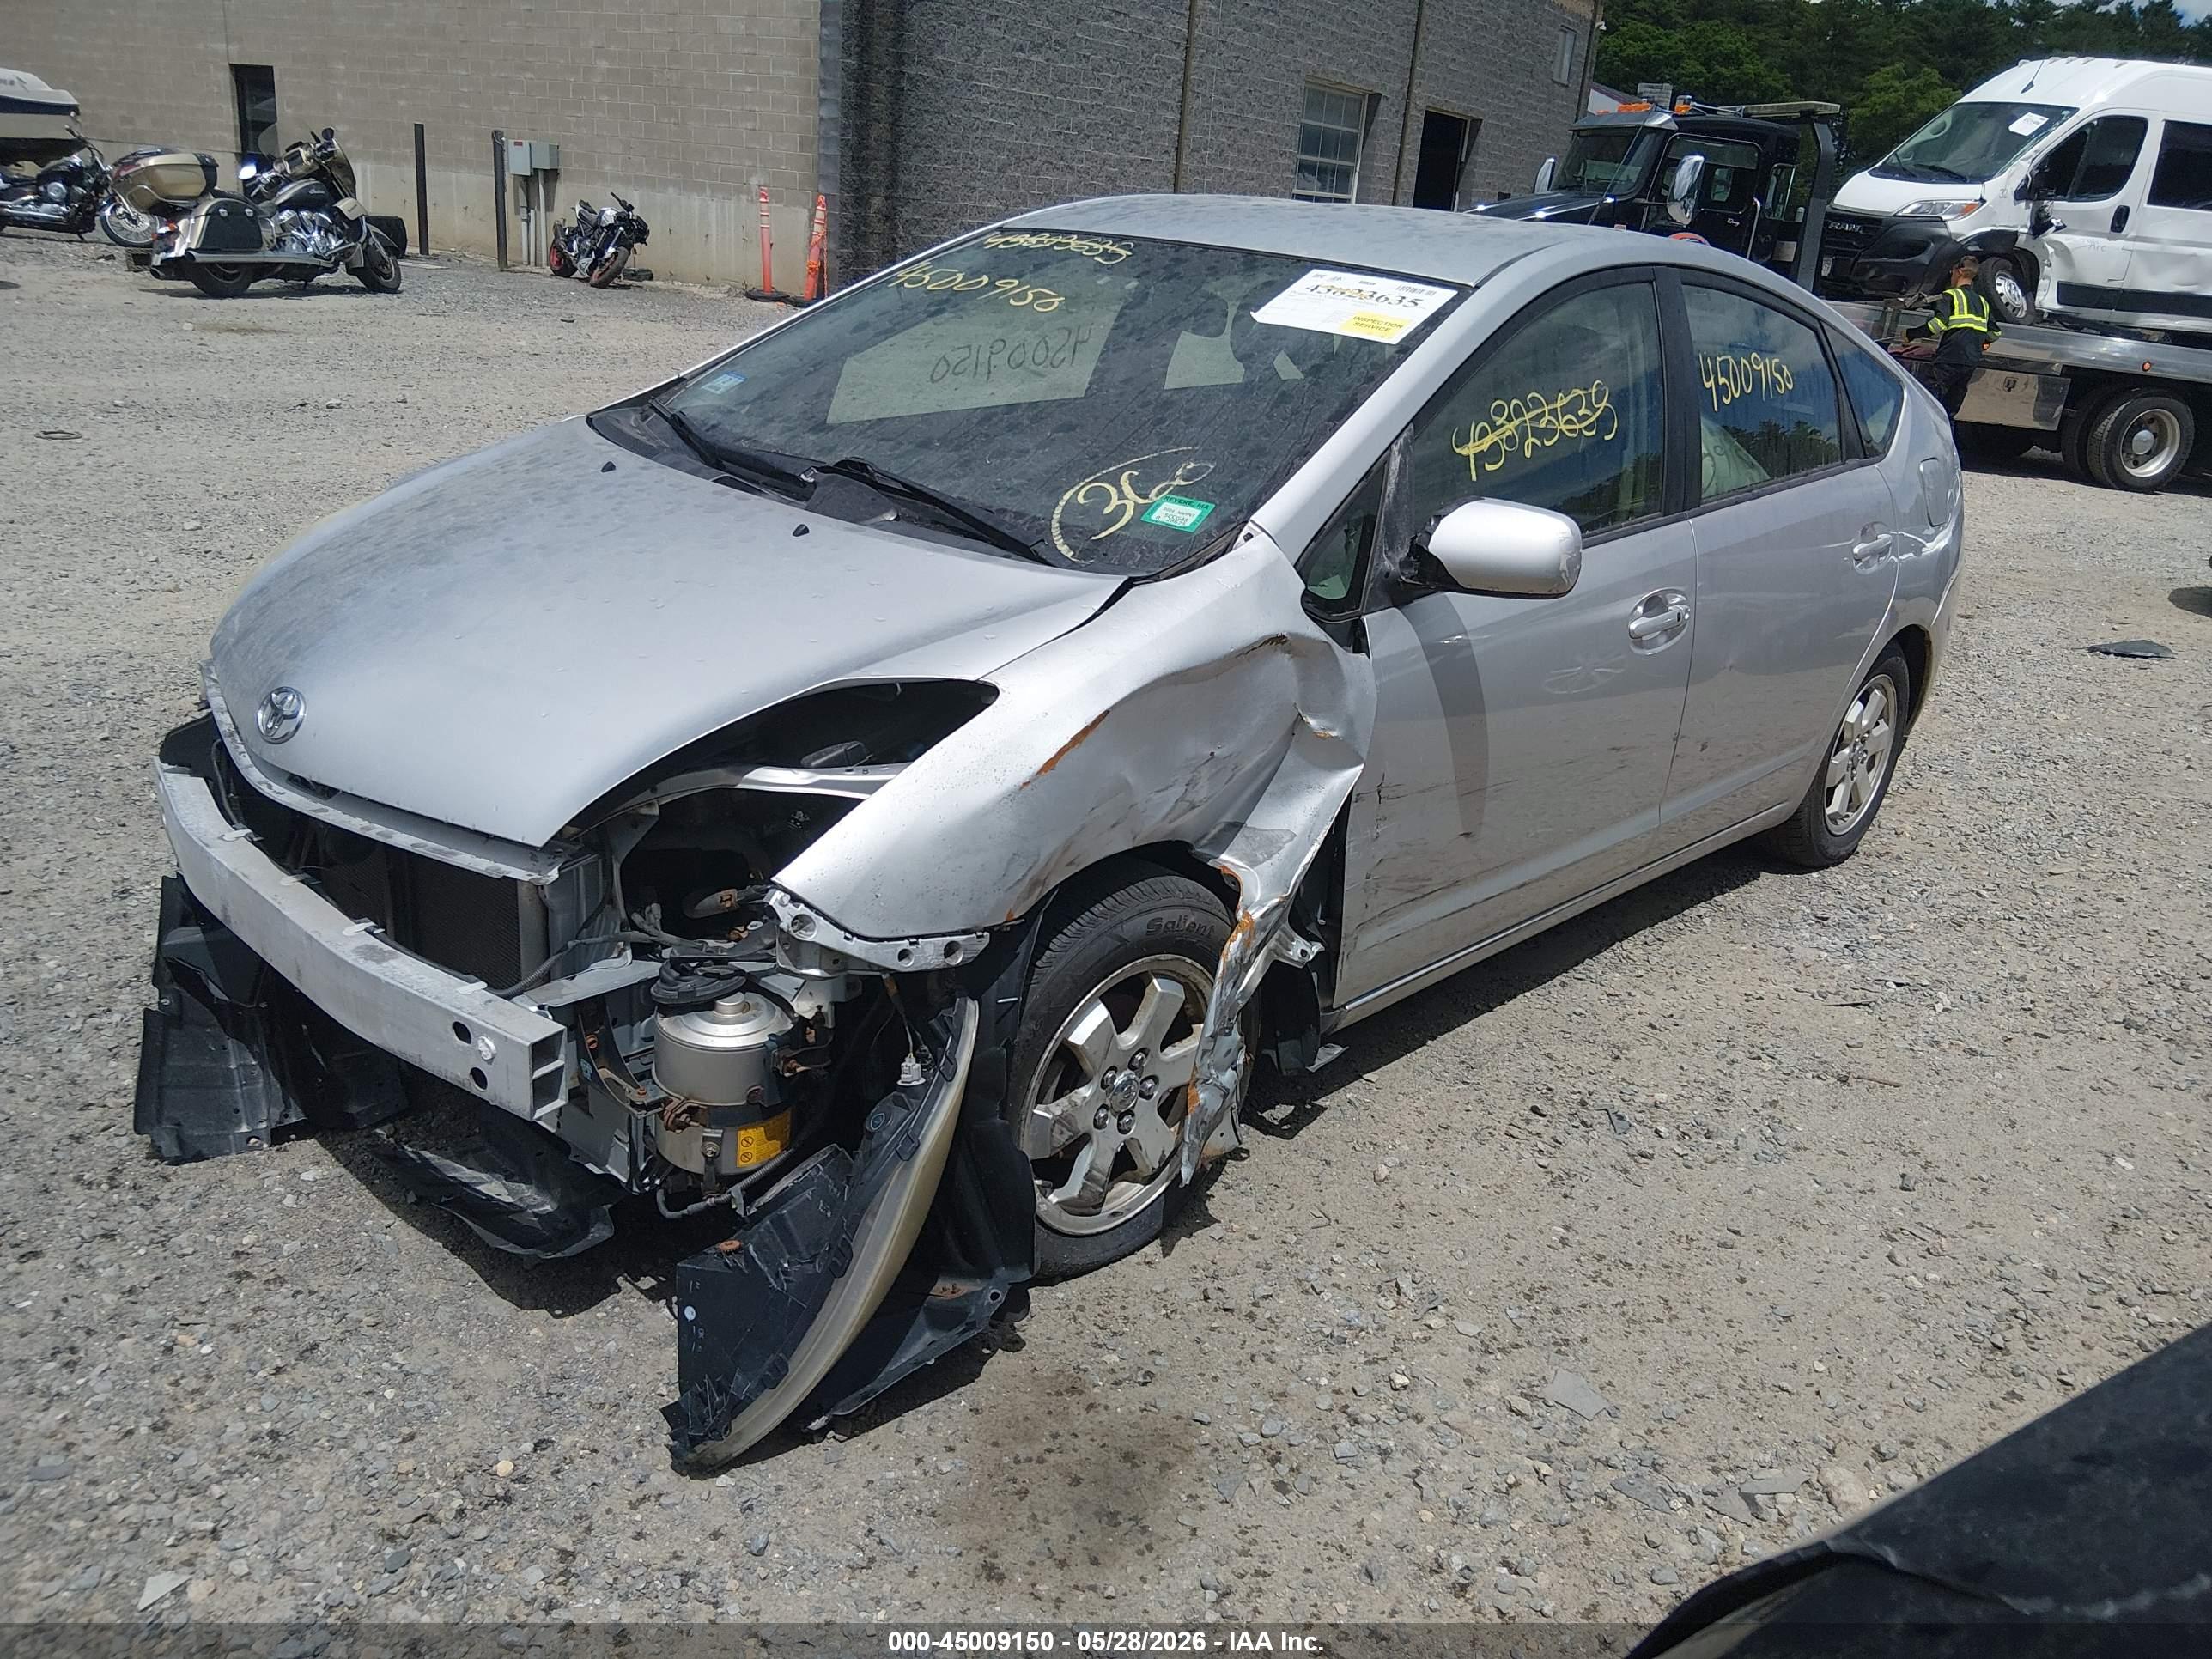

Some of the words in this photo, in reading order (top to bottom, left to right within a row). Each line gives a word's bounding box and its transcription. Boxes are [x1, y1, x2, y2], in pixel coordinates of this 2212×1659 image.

[888, 261, 1066, 312] 45009150
[1352, 314, 1405, 330] INSPECTION
[1352, 321, 1392, 332] SERVICE
[1699, 352, 1794, 412] 45009150
